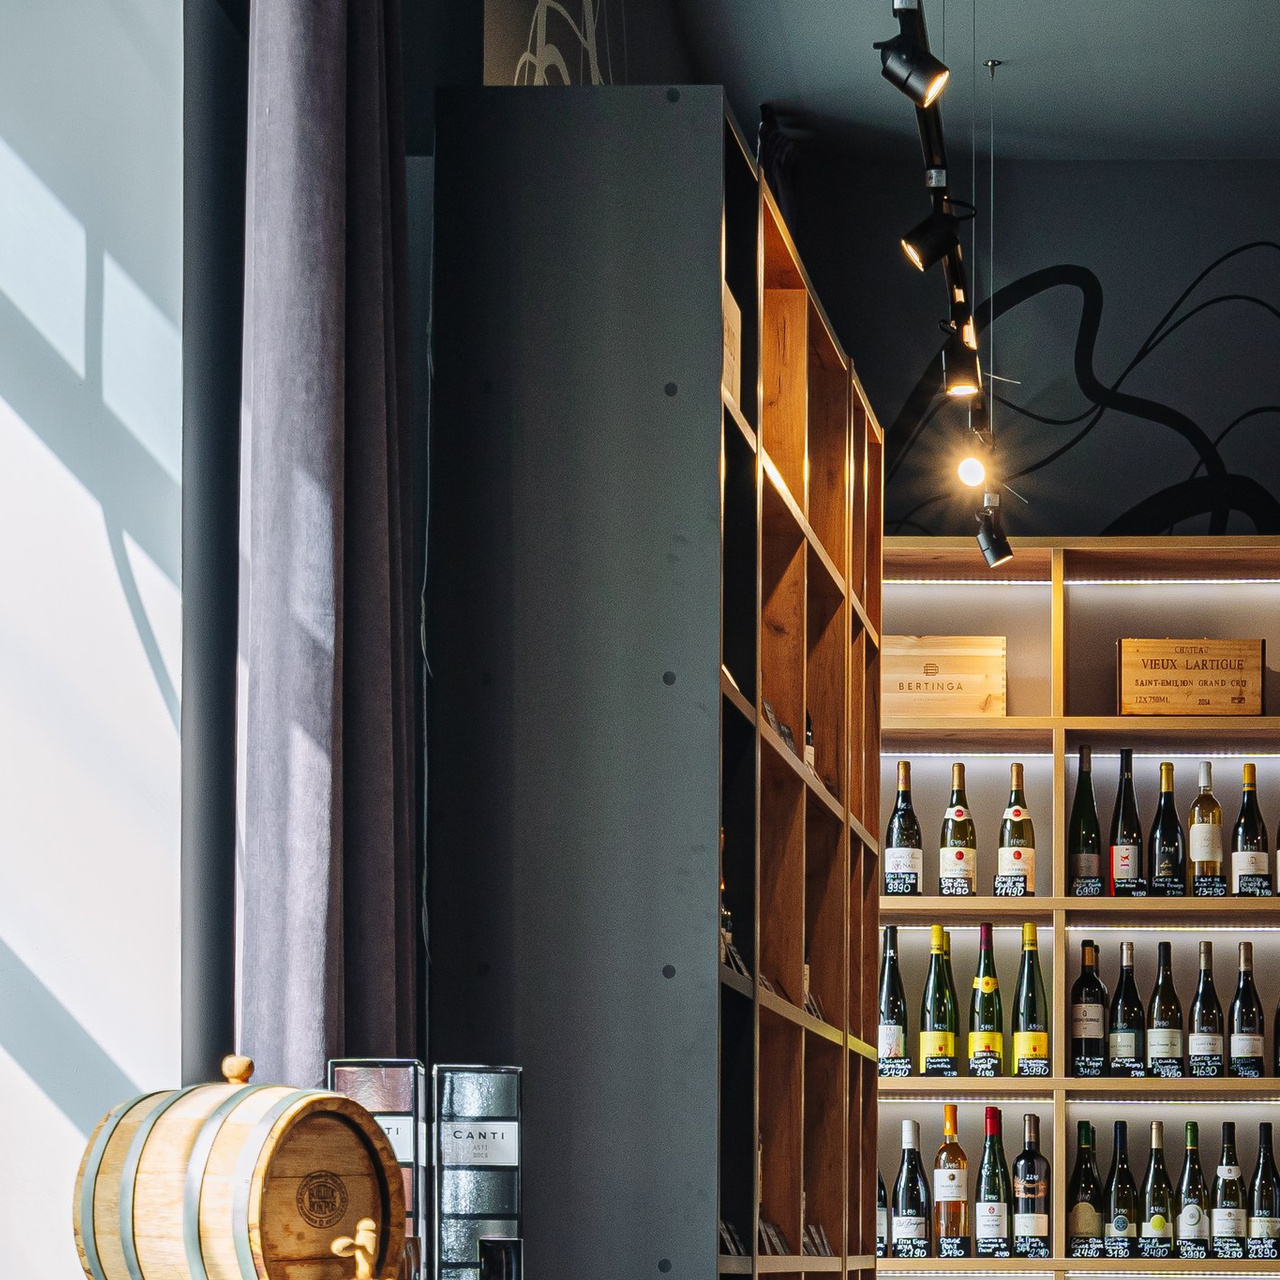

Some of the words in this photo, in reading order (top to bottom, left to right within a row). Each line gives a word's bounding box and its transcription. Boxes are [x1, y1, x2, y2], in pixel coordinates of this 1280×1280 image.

[1141, 658, 1180, 670] VIEUX
[1185, 658, 1245, 671] LARTIGUE
[898, 682, 964, 691] BERTINGA
[1134, 678, 1194, 688] SAINT-EMILION
[1198, 679, 1227, 688] GRAND
[1230, 679, 1247, 688] CRU
[887, 884, 911, 893] 9990
[942, 887, 969, 895] 6490
[995, 887, 1025, 896] 11490
[1076, 887, 1099, 896] 6990
[881, 1069, 909, 1077] 3490
[1021, 1067, 1049, 1075] 3990
[1192, 1066, 1219, 1075] 4690
[453, 1130, 505, 1140] CANTI
[899, 1249, 927, 1258] 2190
[940, 1250, 964, 1258] 3490
[1073, 1249, 1100, 1257] 2490
[1105, 1249, 1130, 1257] 3190
[1141, 1249, 1169, 1257] 2490
[1248, 1249, 1278, 1258] 2890
